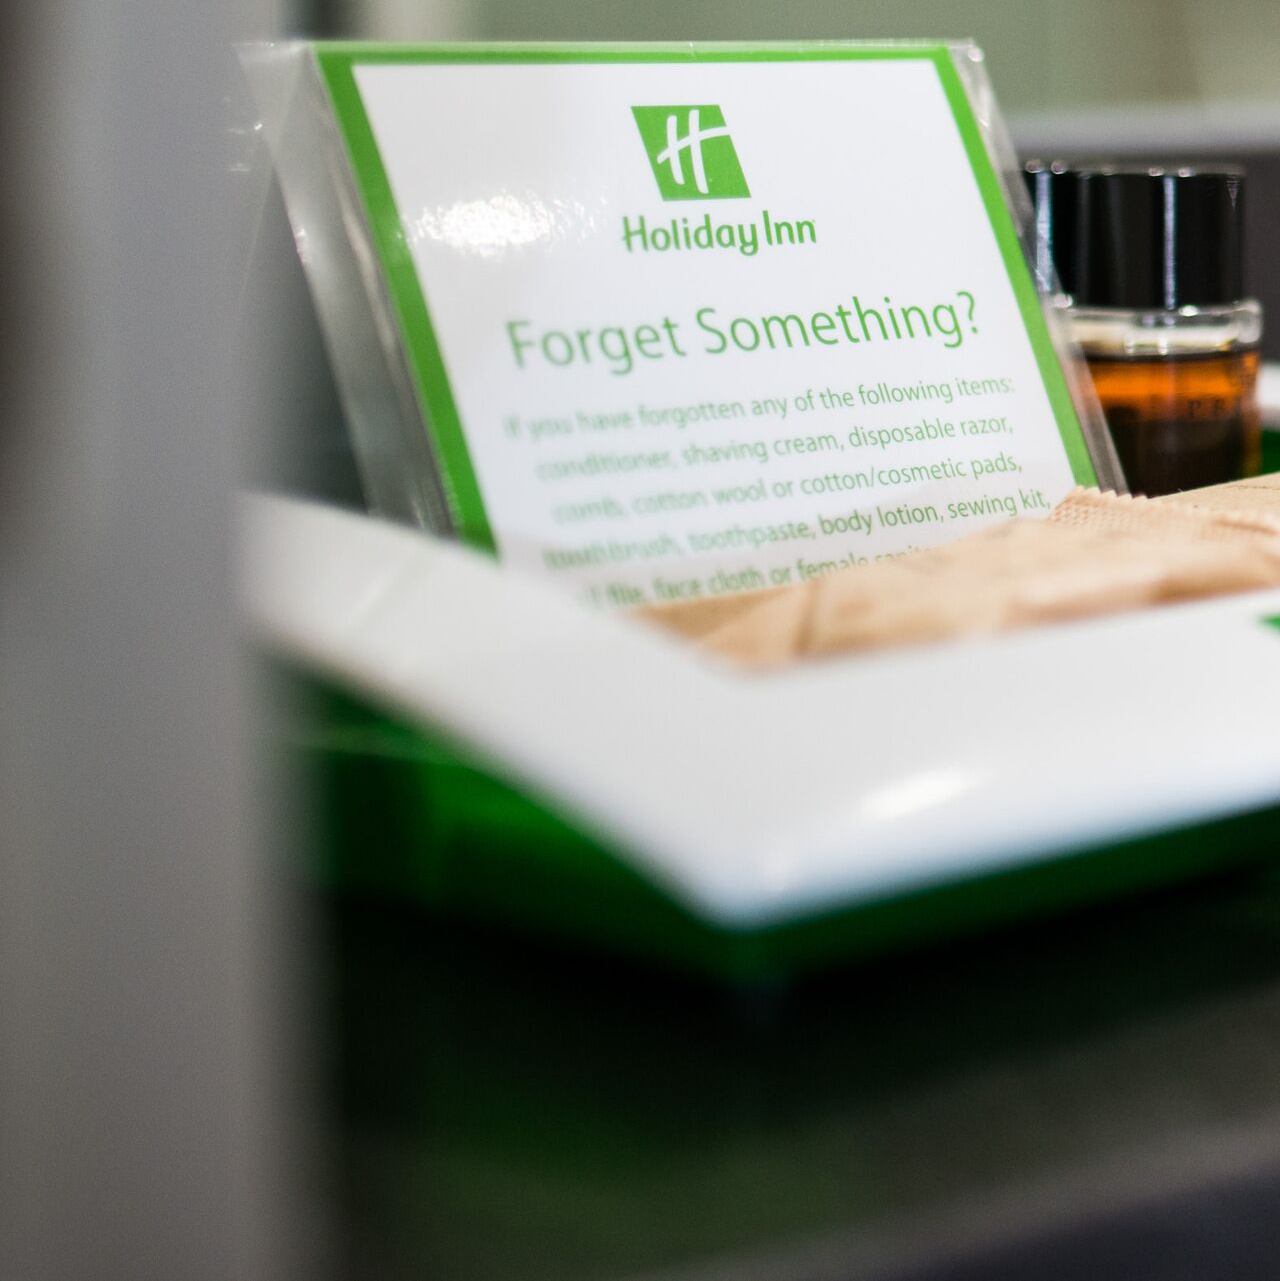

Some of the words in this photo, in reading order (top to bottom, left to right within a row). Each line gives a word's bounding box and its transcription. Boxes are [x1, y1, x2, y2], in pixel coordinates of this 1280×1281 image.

[621, 214, 759, 256] Holiday
[762, 210, 818, 245] Inn
[505, 316, 688, 376] Forget
[695, 291, 979, 353] Something?
[527, 417, 573, 441] you
[575, 408, 633, 433] have
[638, 402, 746, 429] forgotten
[751, 397, 788, 418] any
[794, 389, 816, 413] of
[818, 388, 856, 409] the
[857, 381, 955, 404] following
[955, 376, 1016, 397] items:
[534, 450, 678, 482] conditioner,
[682, 439, 769, 464] shaving
[773, 433, 845, 454] cream,
[848, 418, 956, 450] disposable
[959, 416, 1014, 436] razor,
[630, 490, 709, 516] cotton
[710, 478, 766, 505] wool
[771, 479, 794, 498] or
[800, 458, 968, 496] cotton/cosmetic
[969, 450, 1024, 480] pads,
[687, 520, 817, 551] toothpaste,
[817, 512, 873, 537] body
[876, 503, 945, 527] lotion,
[946, 493, 1019, 518] sewing
[1019, 487, 1051, 510] kit,
[706, 567, 765, 594] cloth
[768, 567, 793, 586] or
